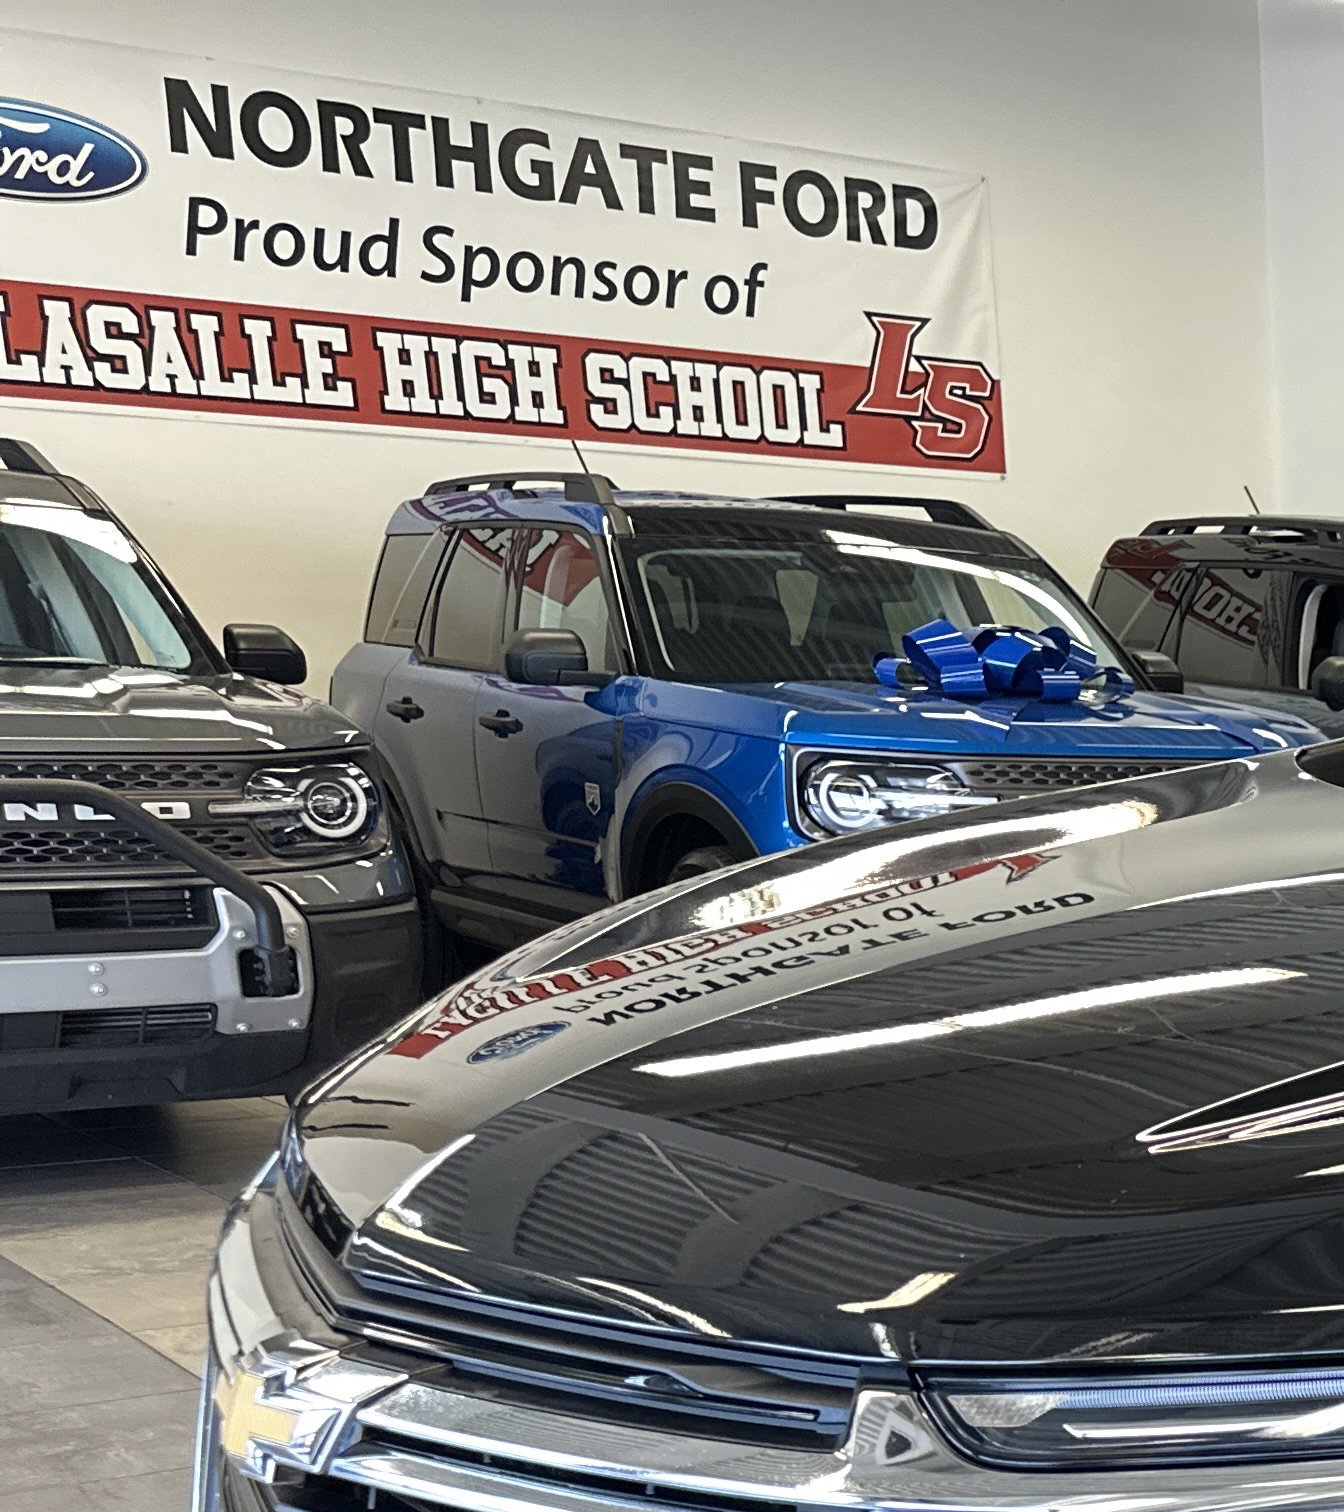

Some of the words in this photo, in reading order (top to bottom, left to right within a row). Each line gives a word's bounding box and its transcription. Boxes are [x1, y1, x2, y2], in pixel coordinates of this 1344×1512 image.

[0, 116, 95, 188] rd
[163, 76, 717, 223] NORTHGATE
[738, 160, 939, 251] FORD
[186, 196, 400, 279] Proud
[420, 225, 689, 309] Sponsor
[703, 262, 769, 318] of
[373, 329, 567, 428] HIGH
[581, 351, 847, 450] SCHOOL
[847, 311, 994, 460] LS
